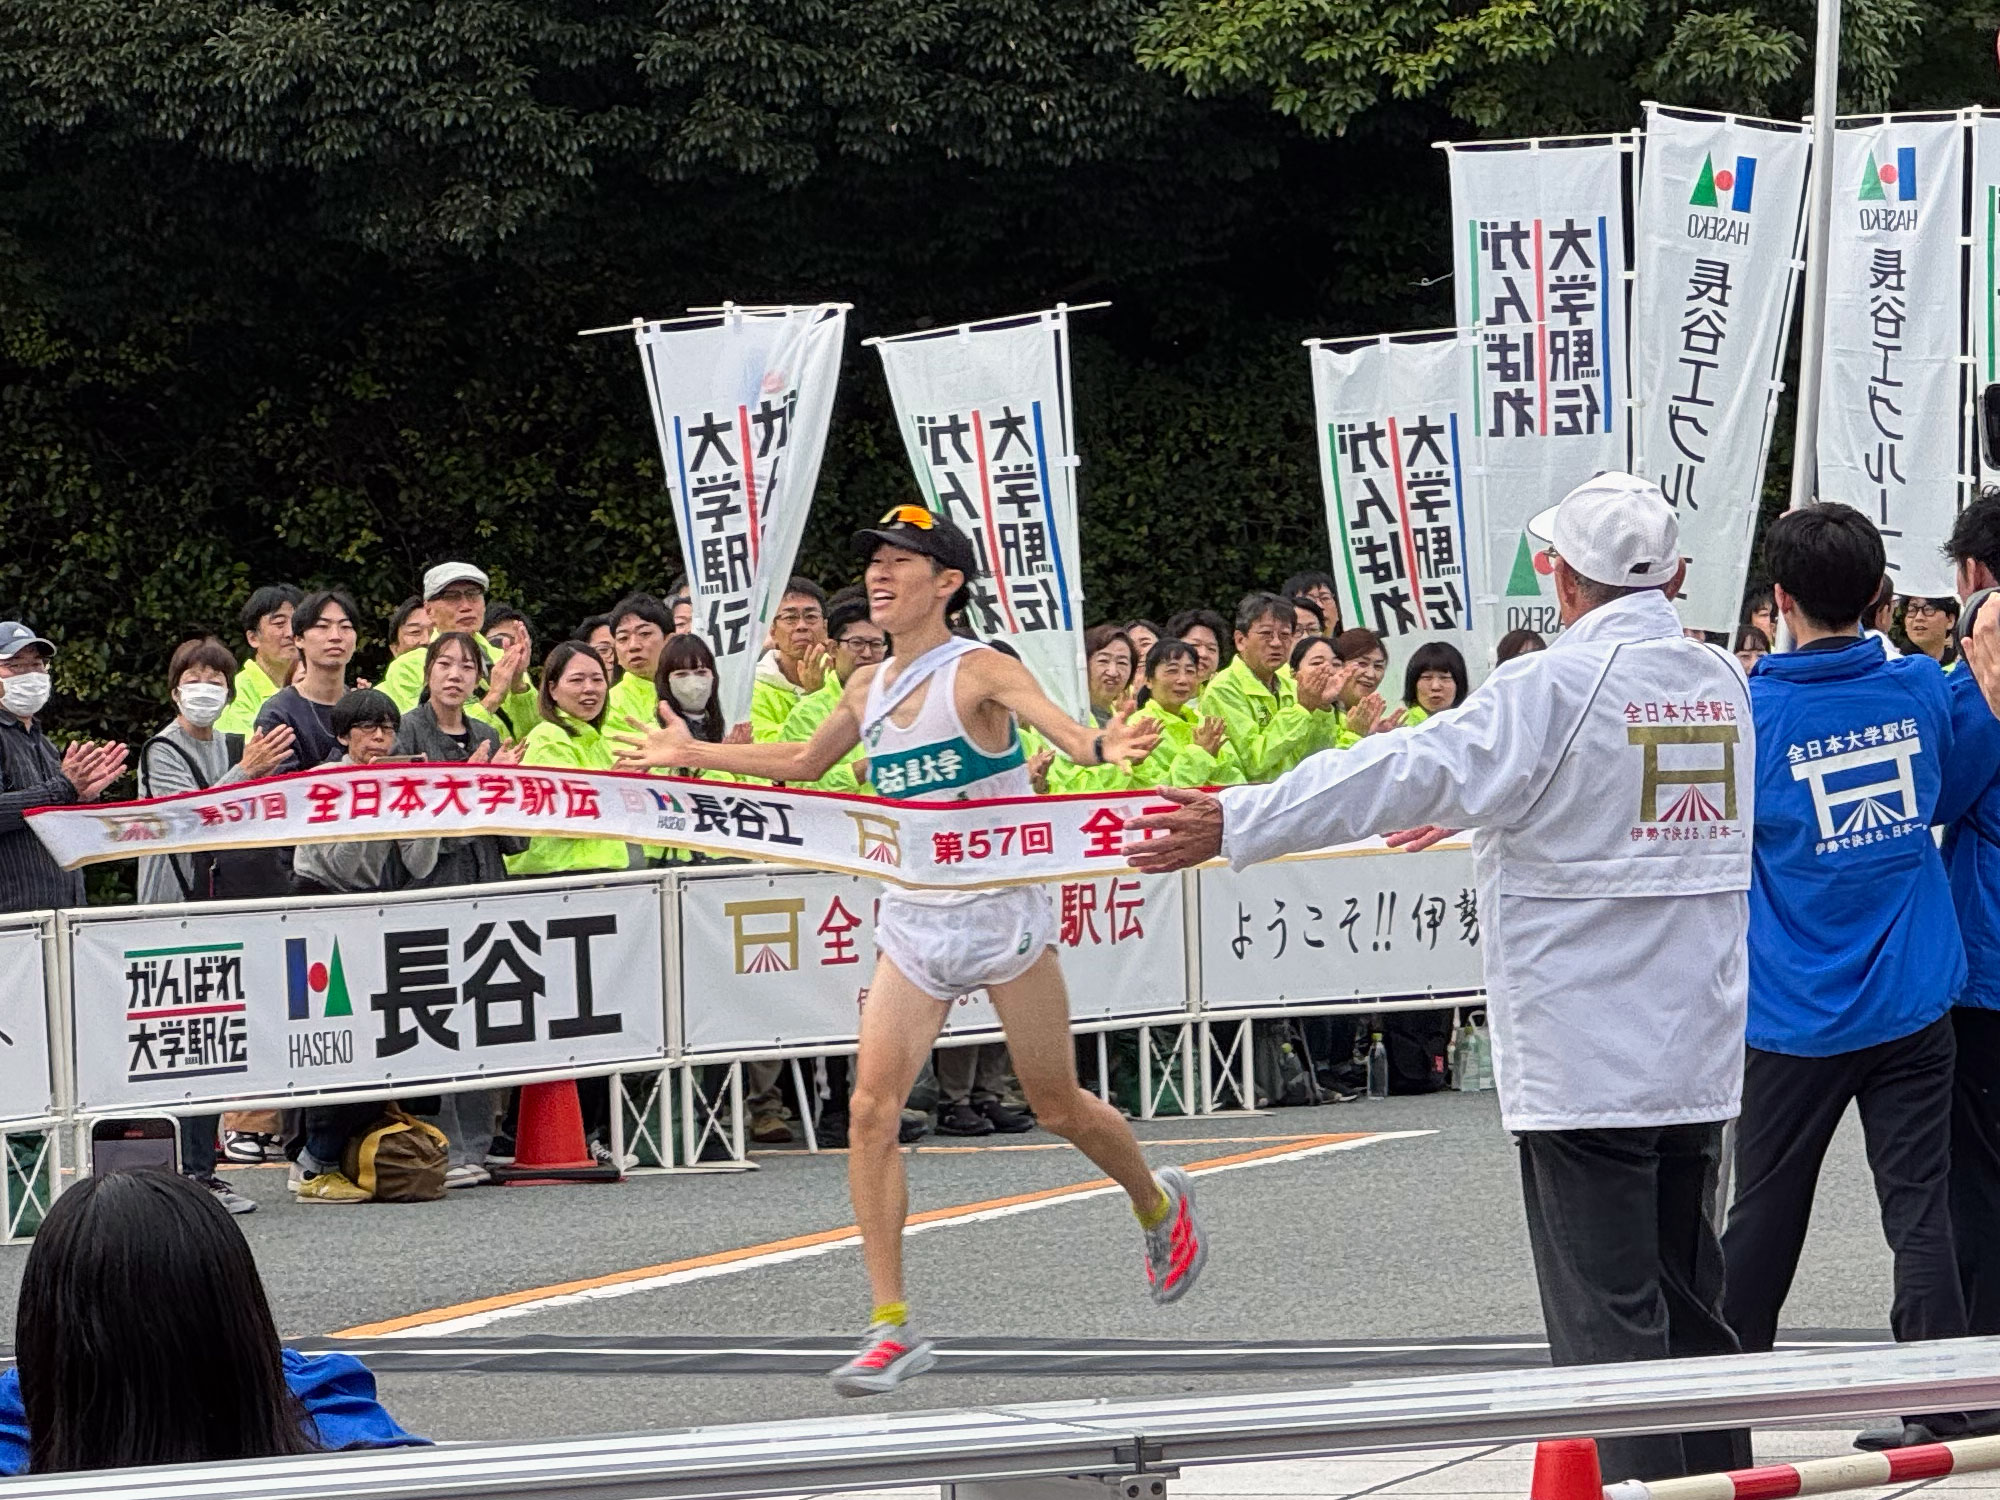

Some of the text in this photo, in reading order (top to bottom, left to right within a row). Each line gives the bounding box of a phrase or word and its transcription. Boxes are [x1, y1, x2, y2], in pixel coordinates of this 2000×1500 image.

[688, 412, 753, 657] 大学駅伝
[1624, 700, 1737, 725] 全日本大学駅伝
[1785, 717, 1920, 764] 全日本大学駅伝
[304, 774, 602, 827] 全日本大学駅伝
[687, 792, 804, 847] 長谷工
[931, 822, 1054, 864] 第57回
[125, 955, 247, 1009] がんばれ
[371, 914, 623, 1058] 長谷工
[128, 1015, 248, 1072] 大学駅伝
[288, 1029, 354, 1069] HASEKO
